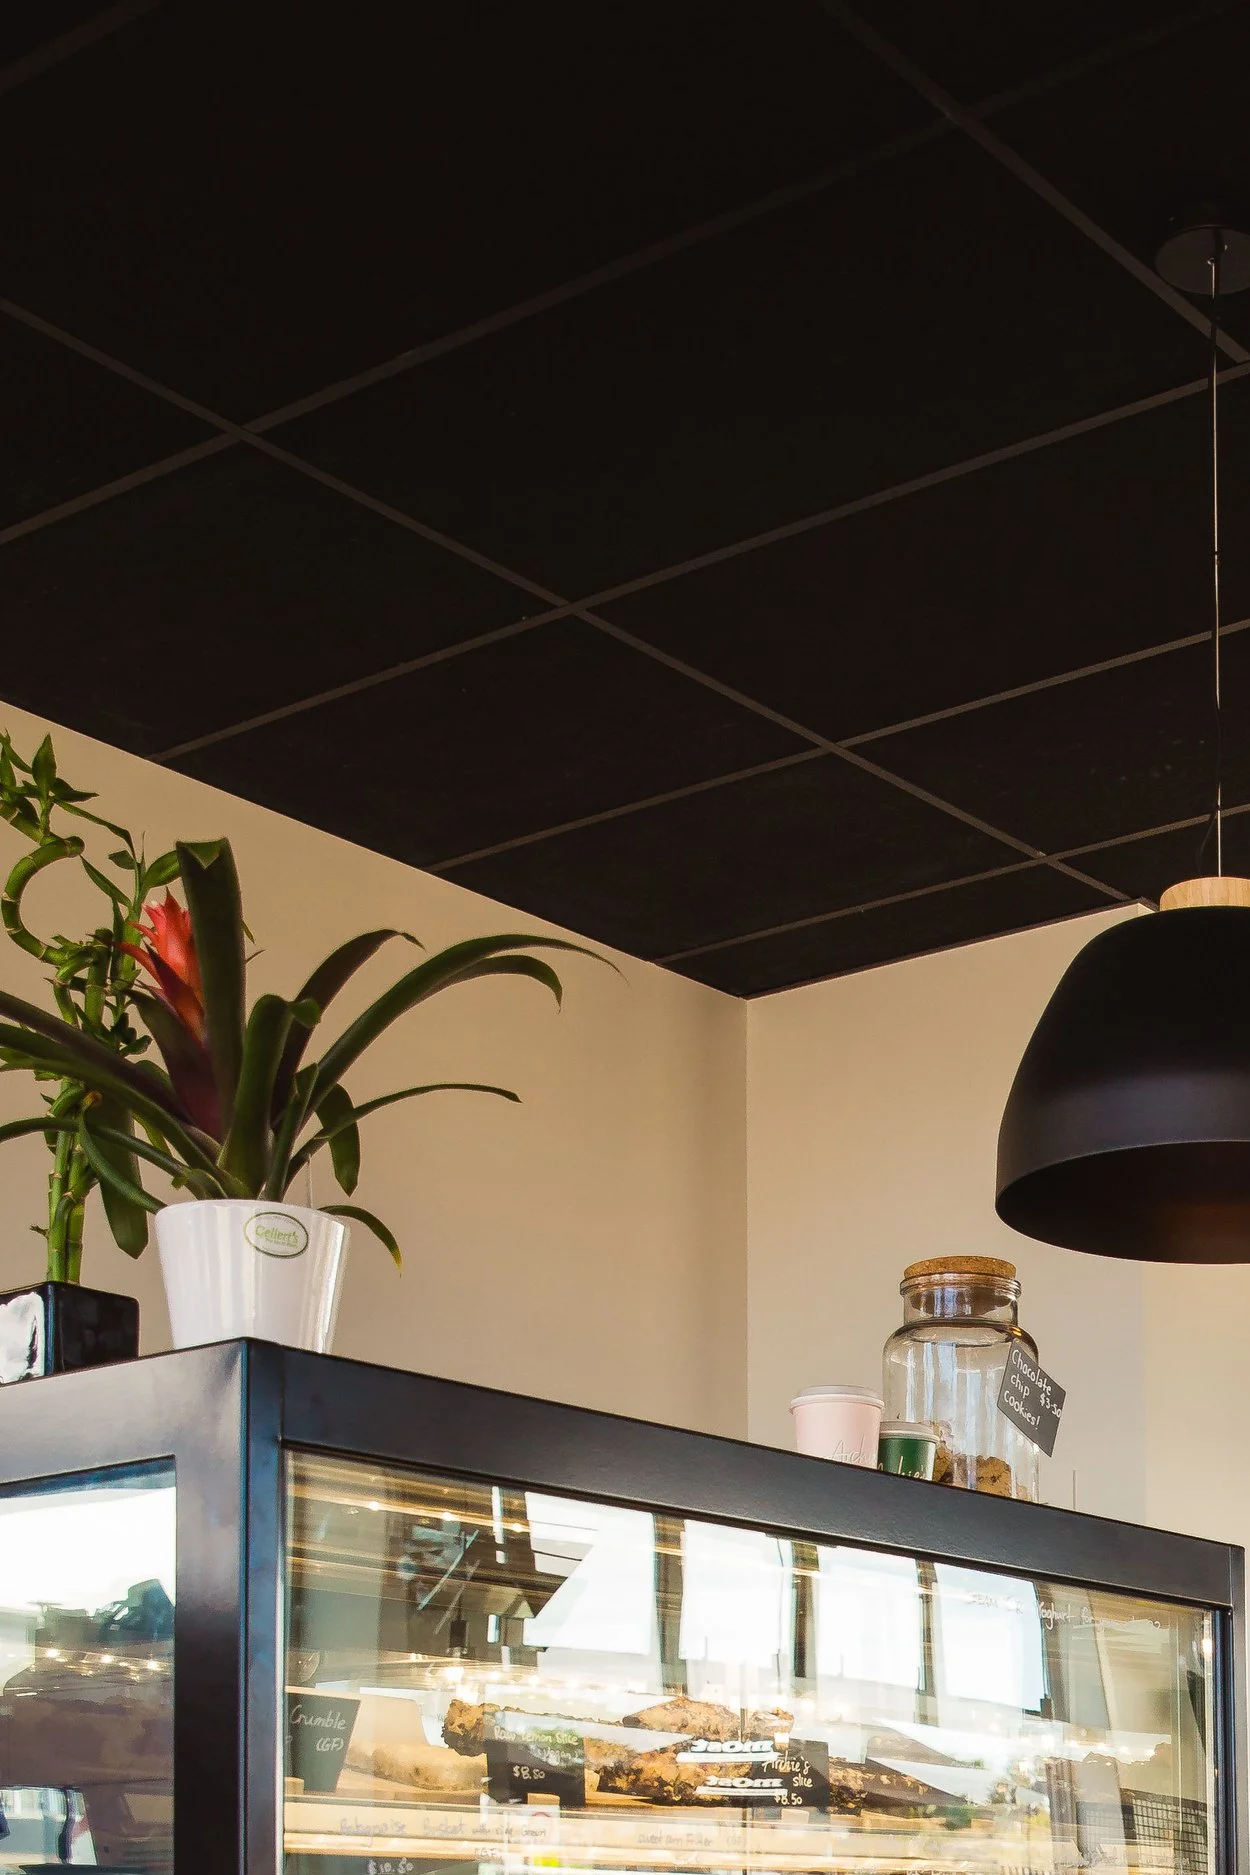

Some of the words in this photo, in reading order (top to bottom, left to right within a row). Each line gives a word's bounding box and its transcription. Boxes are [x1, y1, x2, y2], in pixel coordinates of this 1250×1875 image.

[1012, 1349, 1052, 1396] Chocolate
[1010, 1373, 1030, 1399] chip
[290, 1704, 346, 1730] Crumble
[315, 1737, 345, 1752] (GF)
[512, 1764, 546, 1780] $8.50
